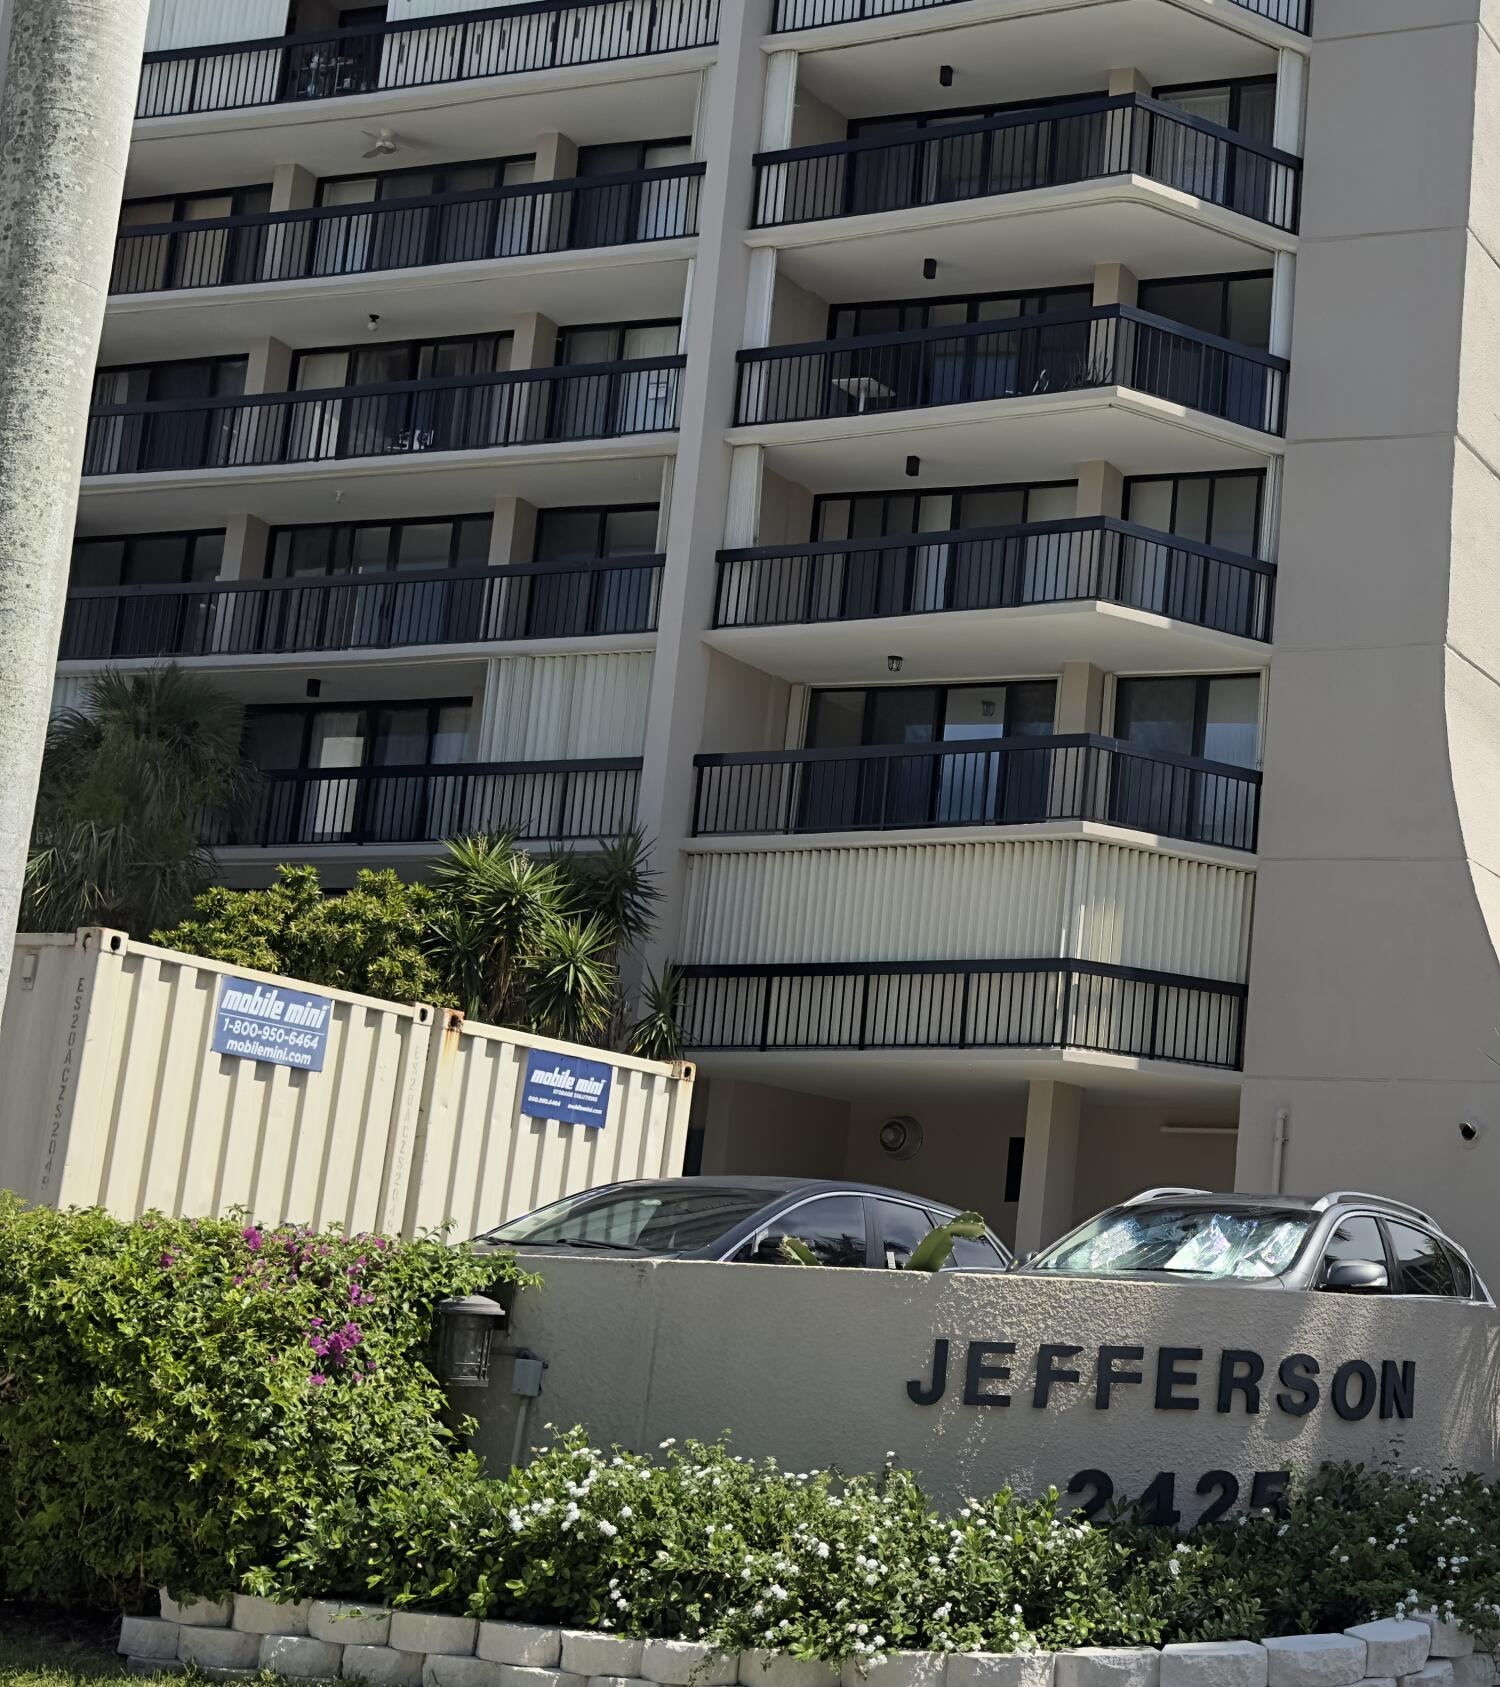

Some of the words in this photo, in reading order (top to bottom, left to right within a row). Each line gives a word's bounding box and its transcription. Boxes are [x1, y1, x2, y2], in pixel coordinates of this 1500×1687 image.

[221, 985, 285, 1020] mobile
[284, 1001, 329, 1029] mini
[223, 1017, 320, 1050] 1-800-950-6464
[226, 1039, 312, 1065] mobilemini.com
[530, 1067, 576, 1090] mobile
[575, 1077, 606, 1096] mini
[906, 1337, 1416, 1422] JEFFERSON
[1067, 1468, 1292, 1528] 2425
